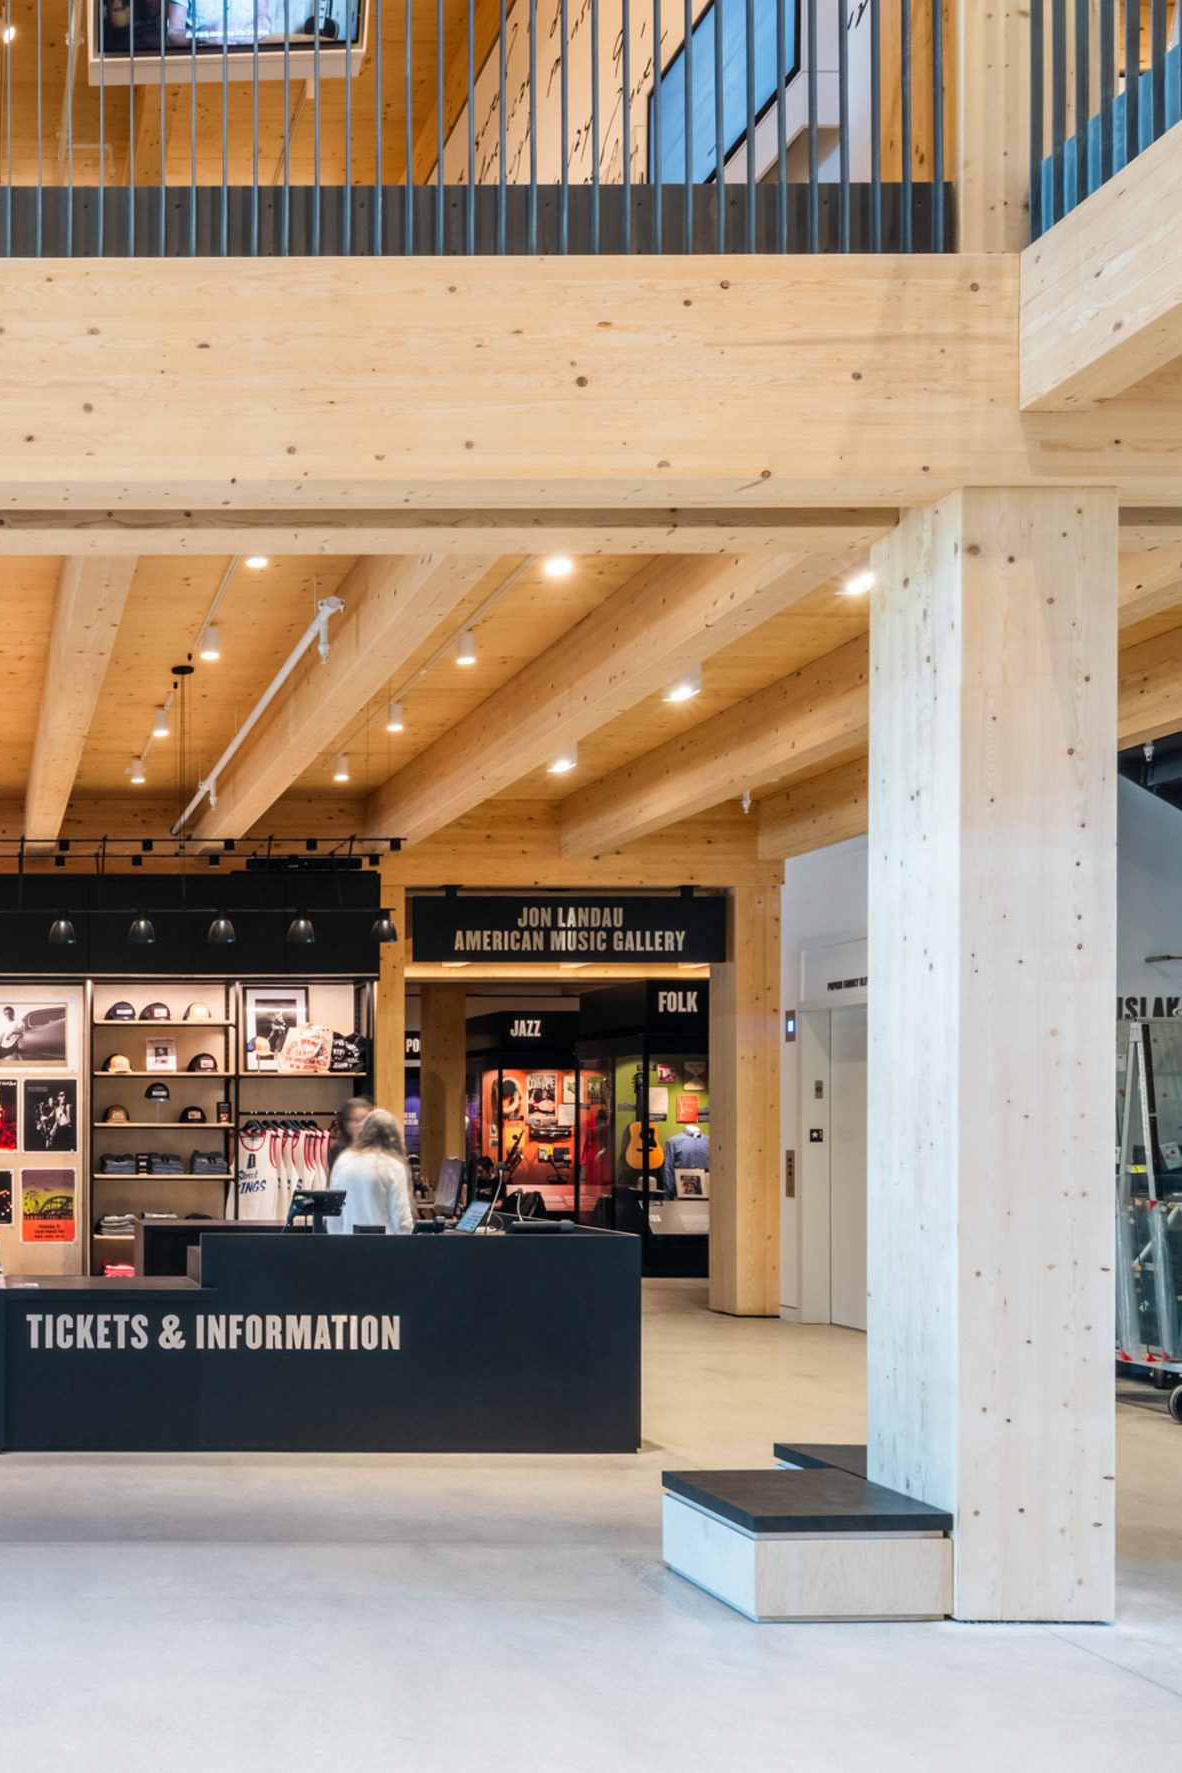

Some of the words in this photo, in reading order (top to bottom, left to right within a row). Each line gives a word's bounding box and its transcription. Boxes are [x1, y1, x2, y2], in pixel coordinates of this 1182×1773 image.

[517, 906, 551, 928] JON
[557, 907, 623, 928] LANDAU
[454, 930, 544, 951] AMERICAN
[550, 930, 608, 951] MUSIC
[613, 930, 686, 951] GALLERY
[657, 991, 698, 1012] FOLK
[510, 1019, 542, 1038] JAZZ
[26, 1313, 149, 1350] TICKETS
[158, 1313, 186, 1350] &
[196, 1314, 401, 1350] INFORMATION
